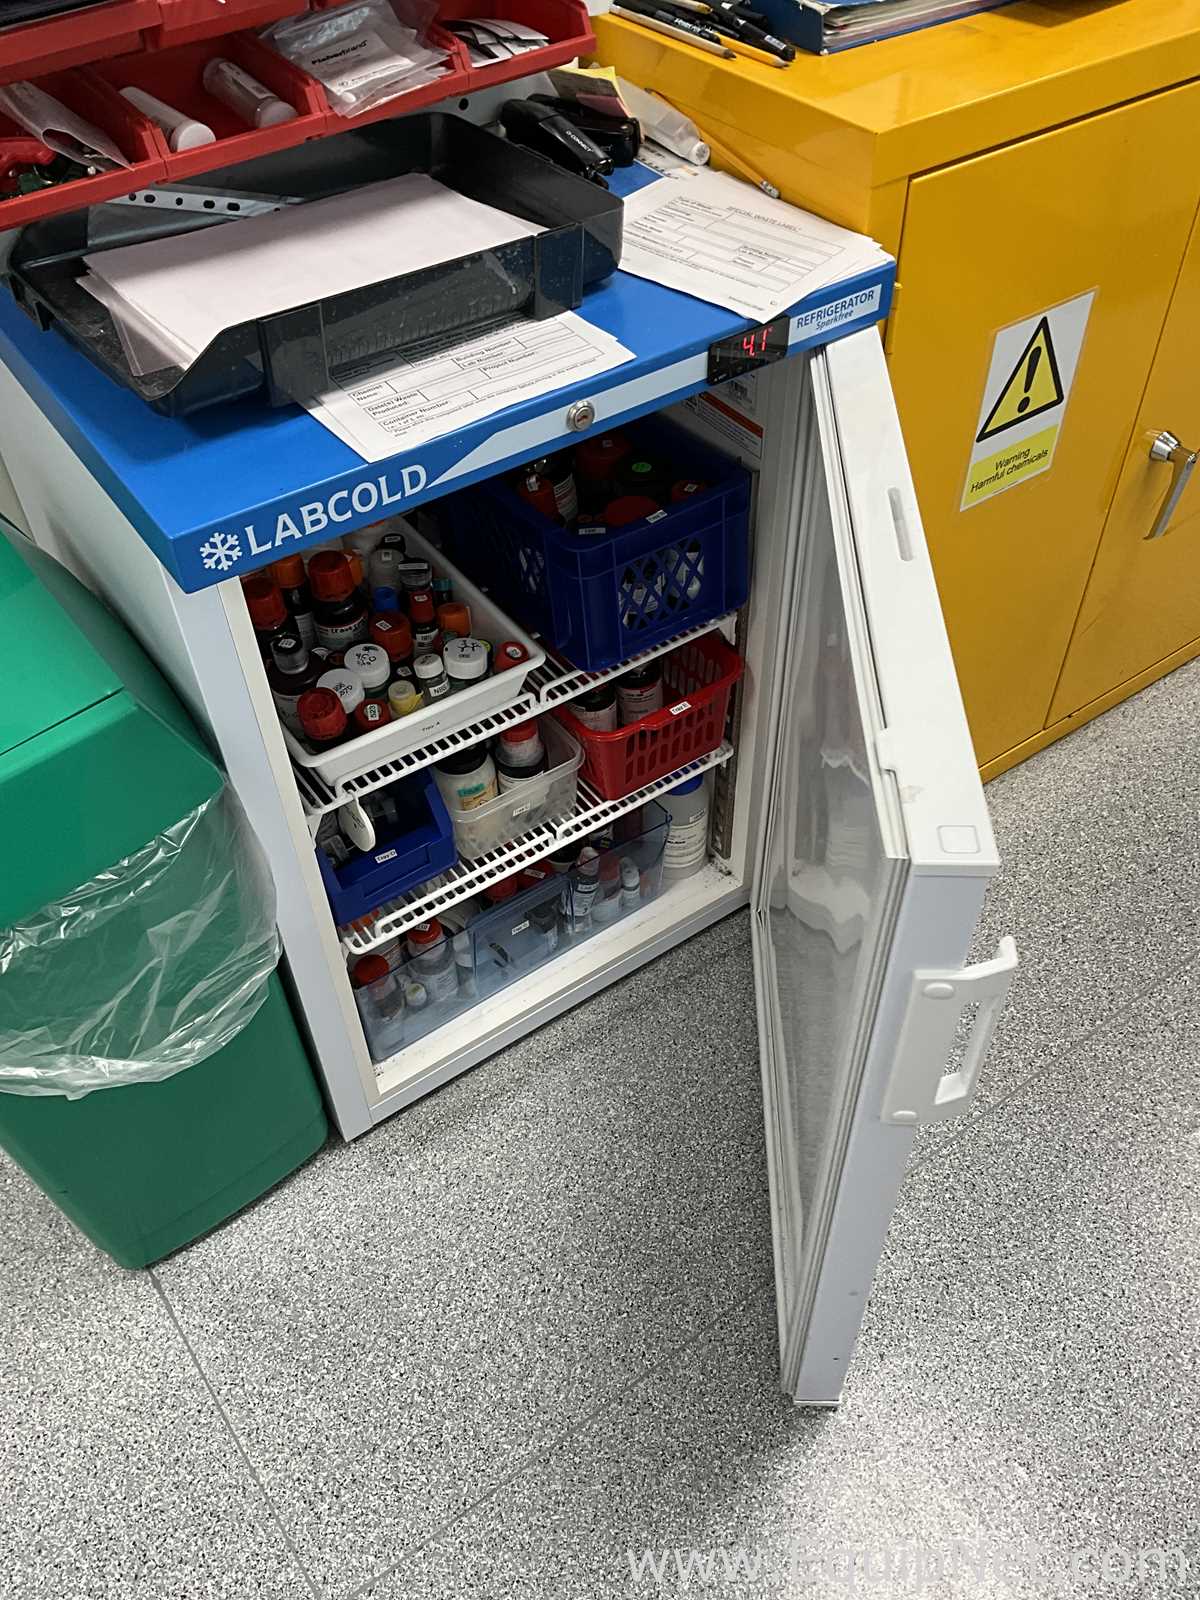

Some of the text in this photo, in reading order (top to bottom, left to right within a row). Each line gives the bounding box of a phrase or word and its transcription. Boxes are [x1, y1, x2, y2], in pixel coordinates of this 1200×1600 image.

[796, 290, 874, 329] REFRIGERATOR
[815, 309, 854, 331] Sparkfree
[970, 449, 1049, 493] Harmful chemicals
[995, 448, 1031, 471] Warning
[244, 464, 427, 556] LABCOLD
